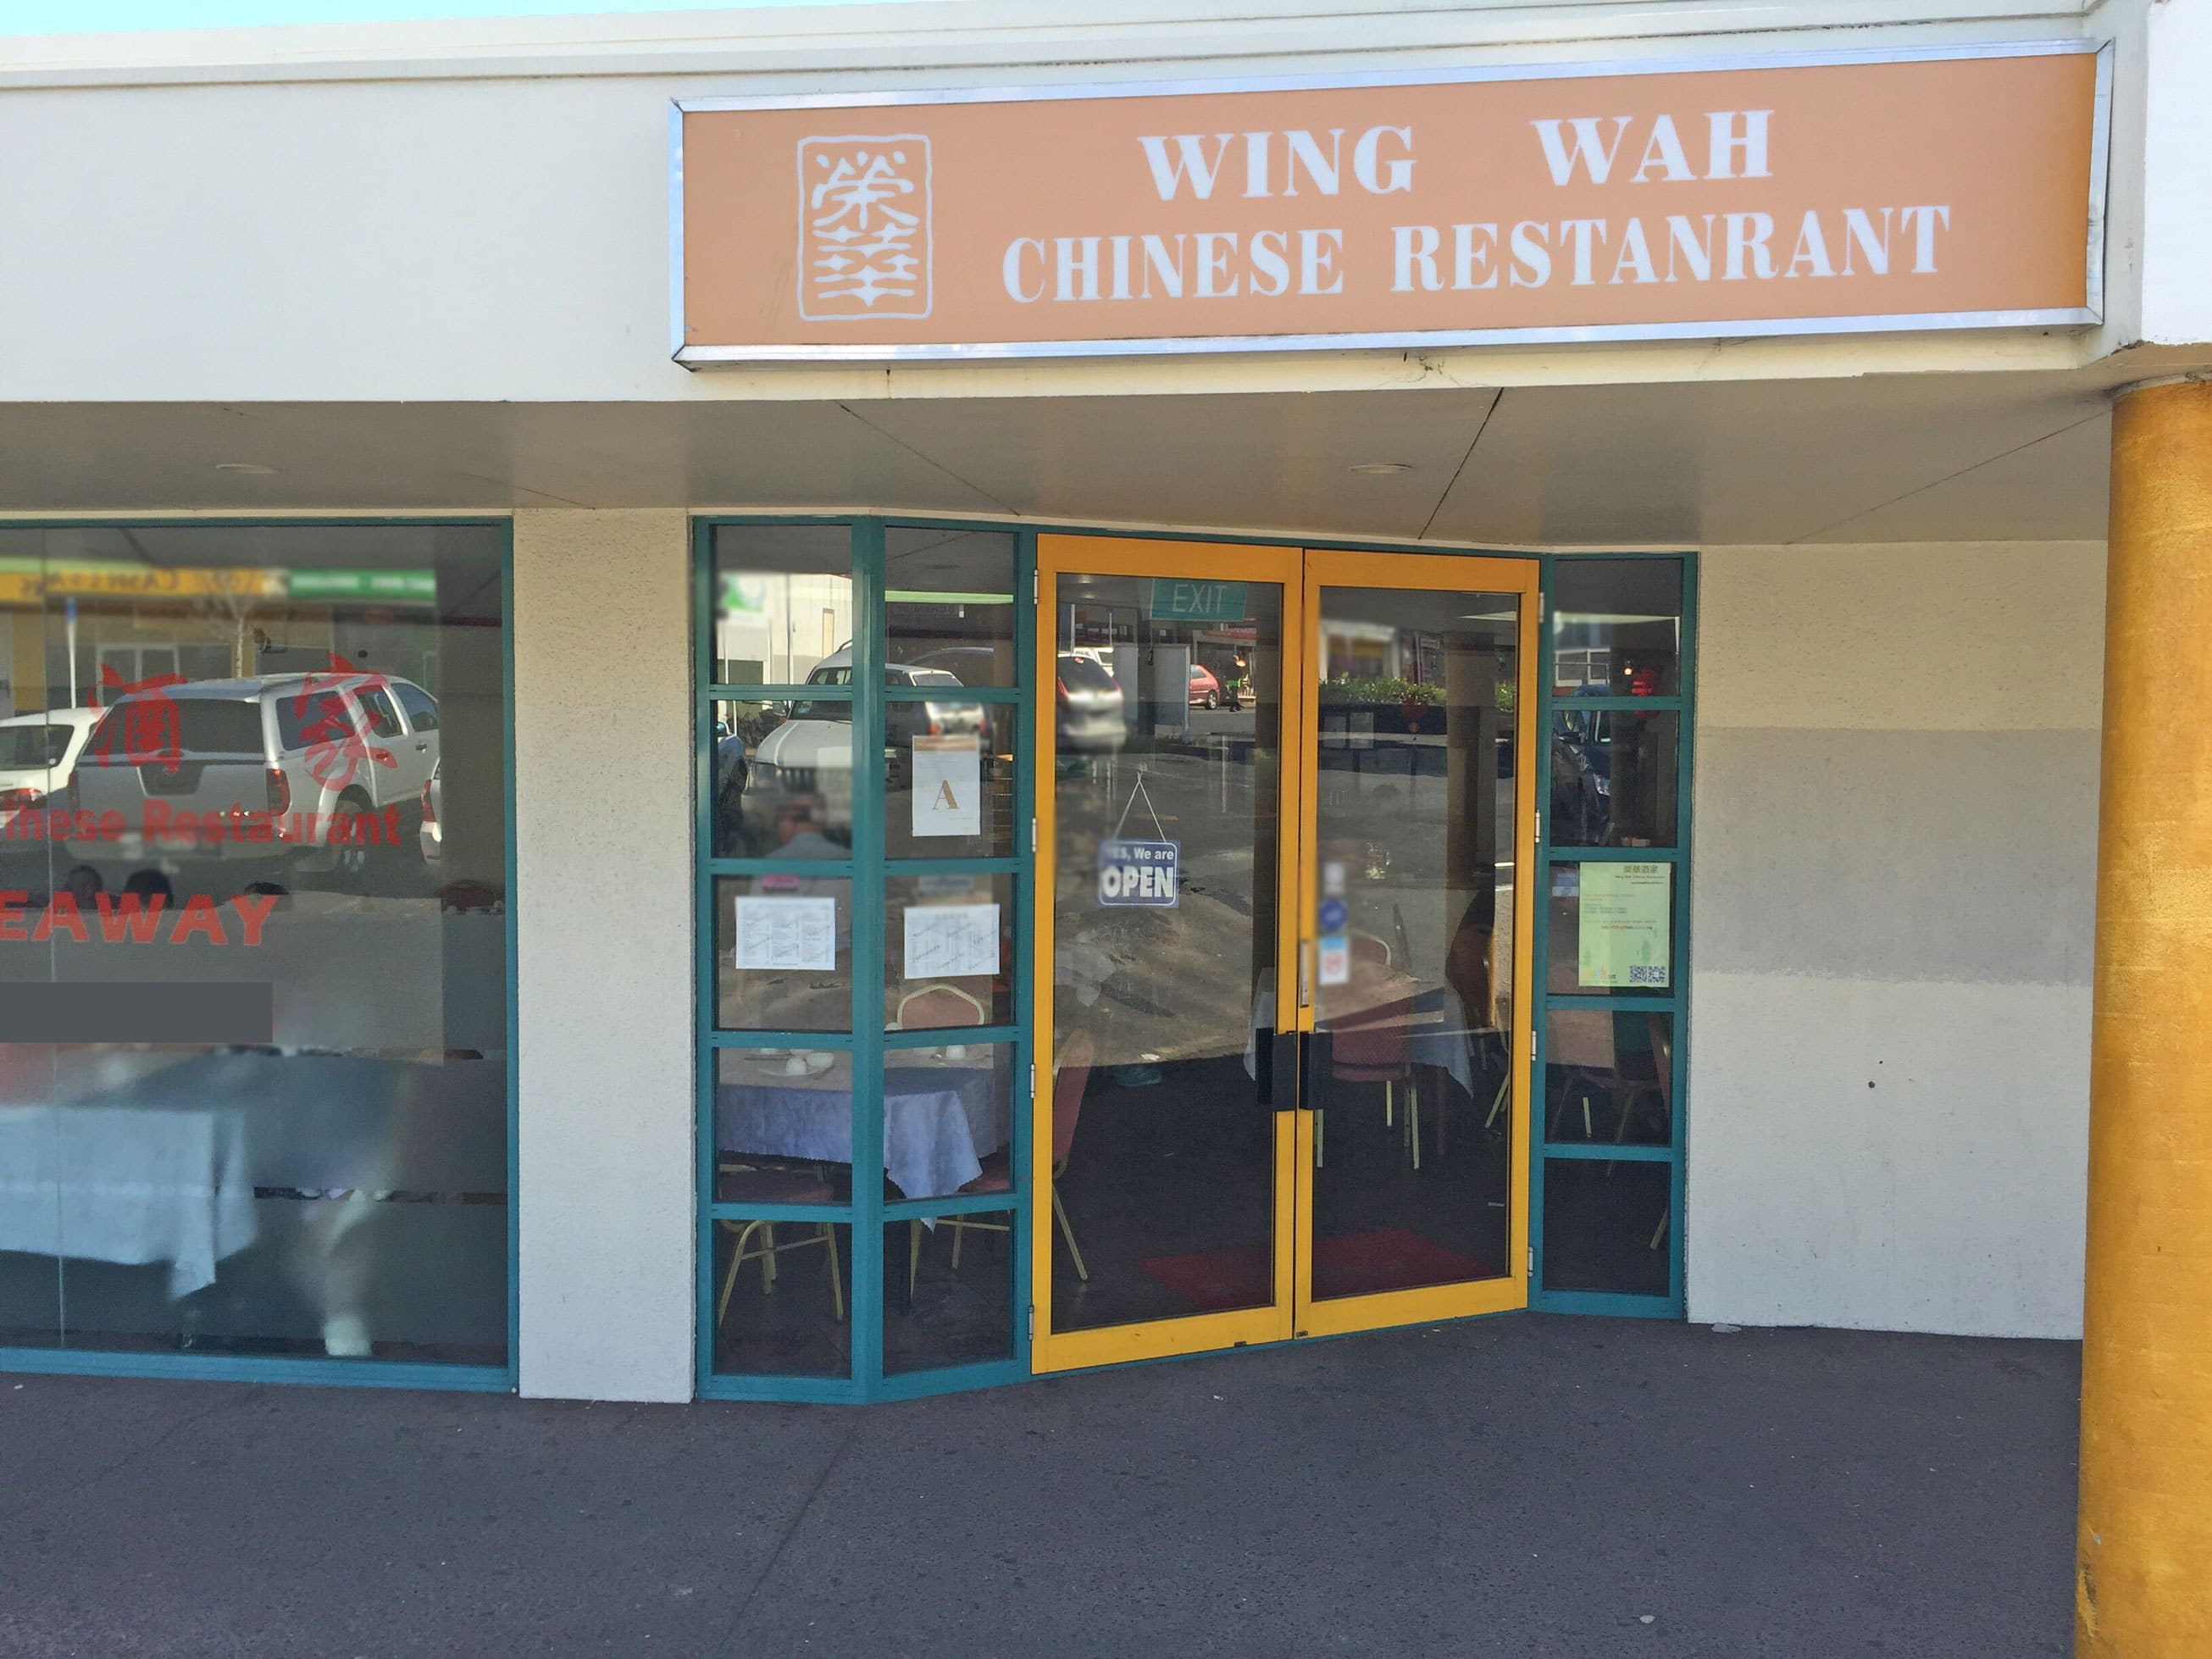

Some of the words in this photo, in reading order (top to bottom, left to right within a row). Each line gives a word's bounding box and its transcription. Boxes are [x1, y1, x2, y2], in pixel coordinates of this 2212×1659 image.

[1138, 125, 1418, 203] WING
[1530, 109, 1776, 187] WAH
[1003, 229, 1344, 304] CHINESE
[1390, 205, 1952, 293] RESTANRANT
[1172, 583, 1228, 613] EXIT
[932, 780, 960, 810] A
[143, 799, 402, 845] Restaurant
[1134, 846, 1151, 859] We
[1154, 849, 1174, 860] are
[1101, 865, 1174, 898] OPEN
[0, 891, 278, 945] EAWAY
